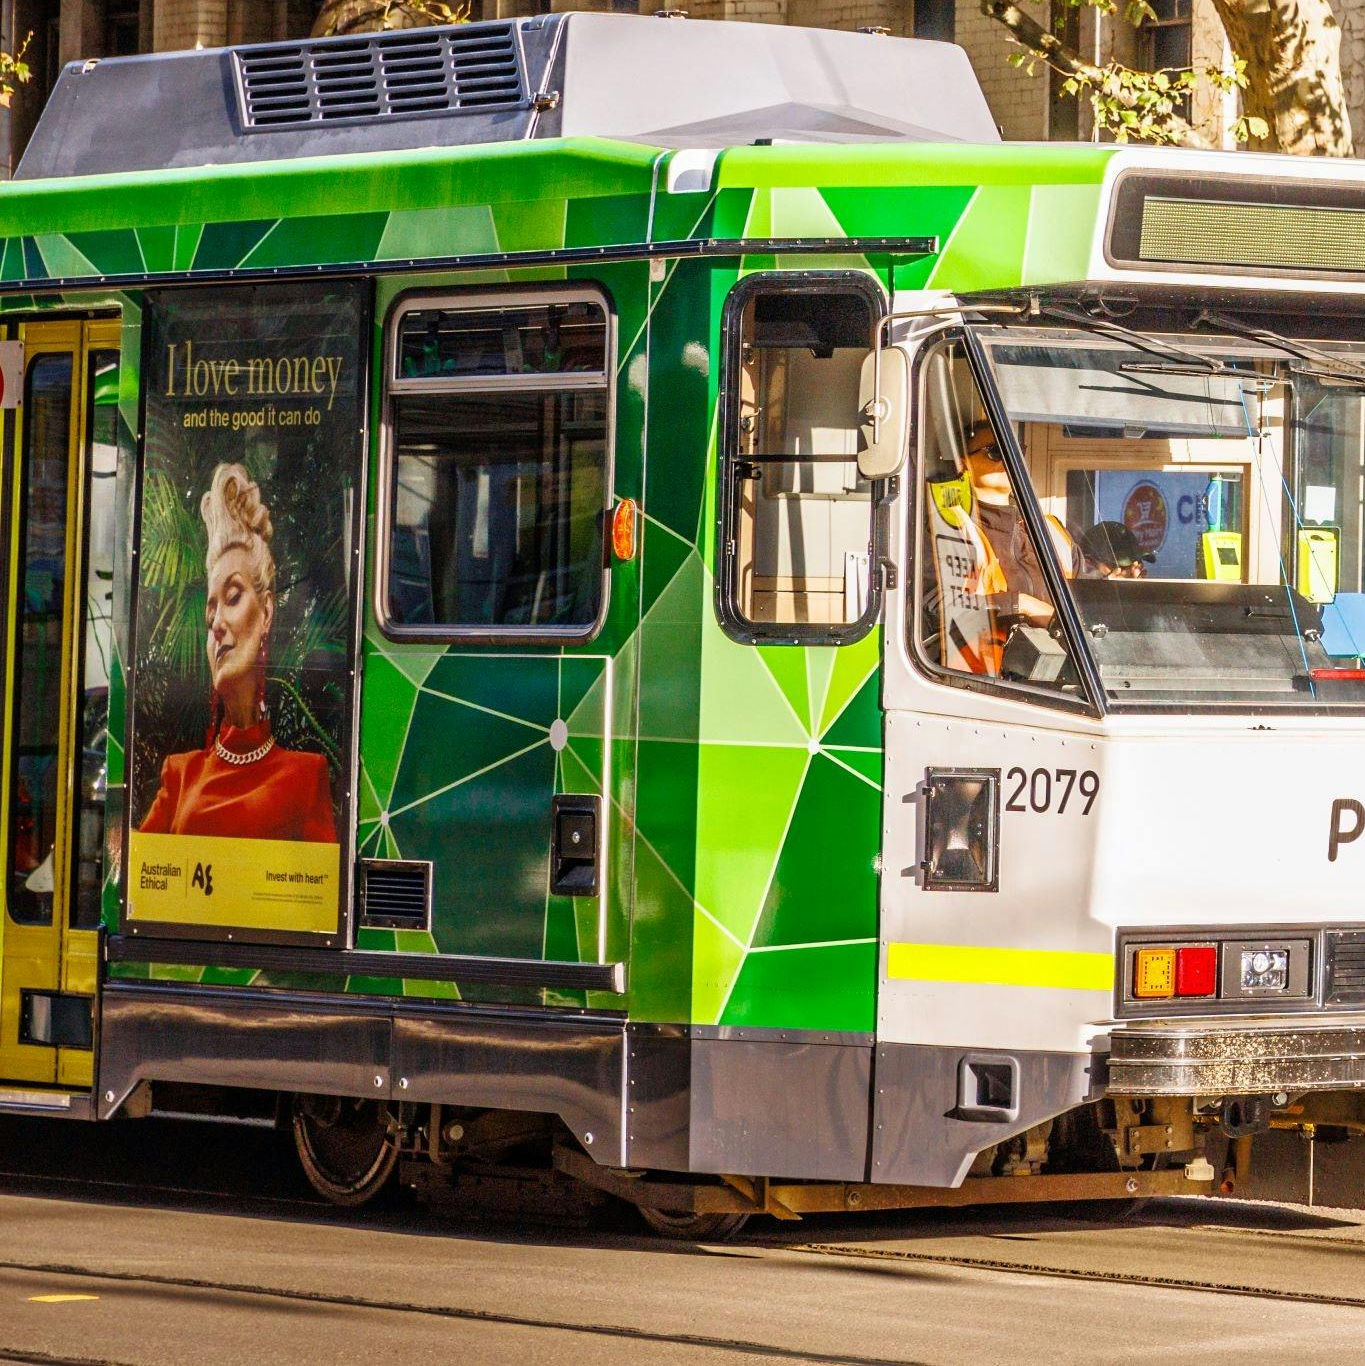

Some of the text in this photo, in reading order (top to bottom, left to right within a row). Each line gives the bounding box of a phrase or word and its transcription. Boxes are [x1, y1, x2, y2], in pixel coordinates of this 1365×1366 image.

[165, 339, 343, 410] I love money
[183, 406, 321, 431] and the good it can do
[1005, 766, 1100, 816] 2079
[141, 861, 182, 878] Australian
[266, 870, 288, 883] Invest
[288, 872, 304, 884] with
[140, 875, 168, 891] Ethical
